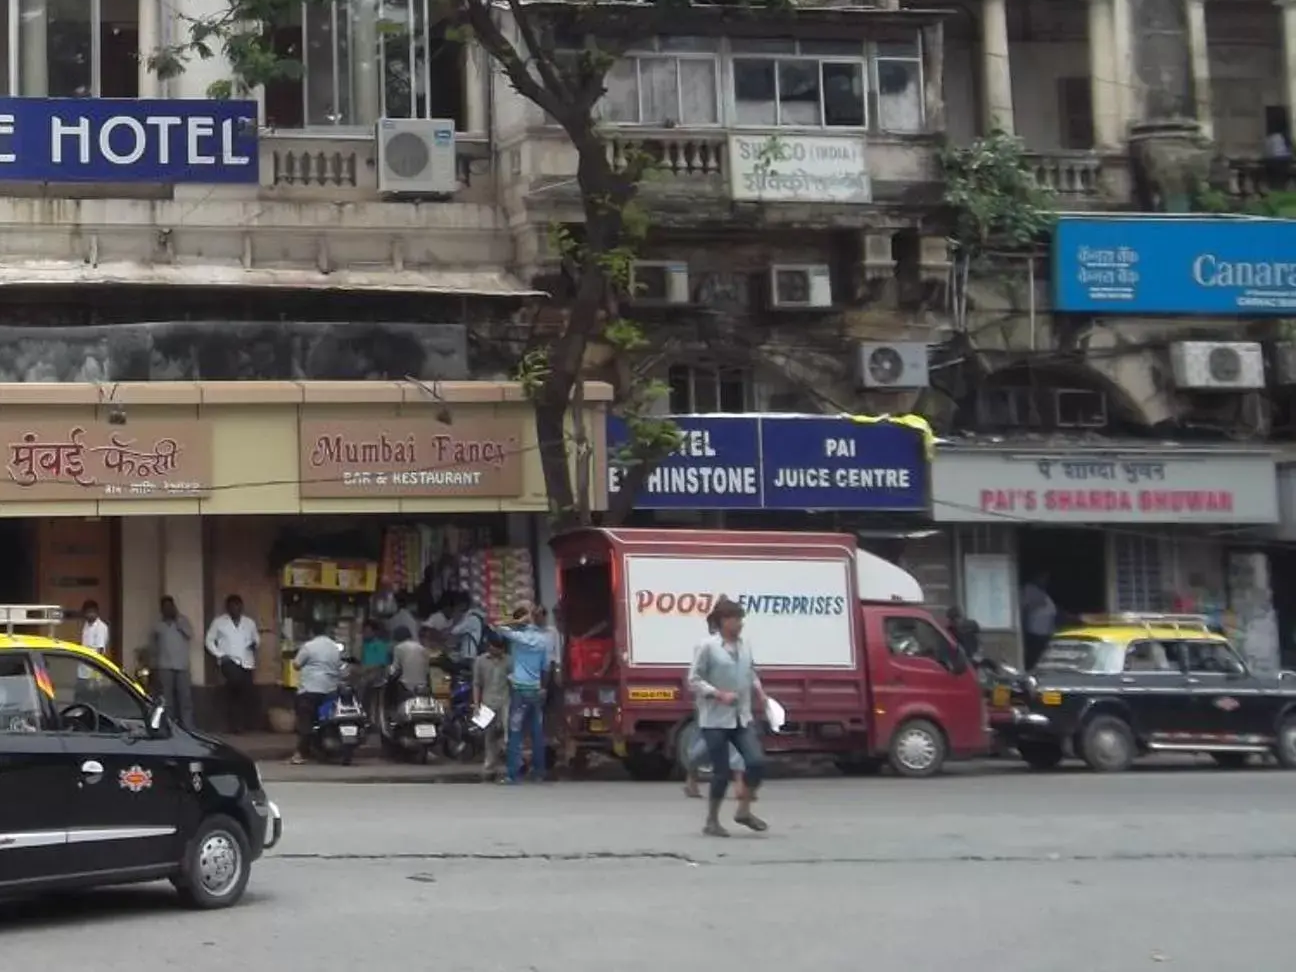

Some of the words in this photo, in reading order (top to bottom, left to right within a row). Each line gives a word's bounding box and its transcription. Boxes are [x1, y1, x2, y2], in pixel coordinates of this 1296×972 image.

[51, 115, 250, 164] HOTEL
[6, 428, 96, 486] मुंबई
[311, 434, 417, 467] Mumbai
[431, 435, 504, 470] Fancy
[825, 439, 856, 457] PAI
[393, 471, 482, 485] RESTAURANT
[608, 466, 756, 495] EHINSTONE
[774, 468, 831, 488] JUICE
[835, 468, 911, 488] CENTRE
[979, 489, 1037, 512] PAI'S
[1044, 489, 1133, 512] SHARDA
[1138, 489, 1235, 513] BHUWAN
[738, 593, 846, 616] ENTERPRISES
